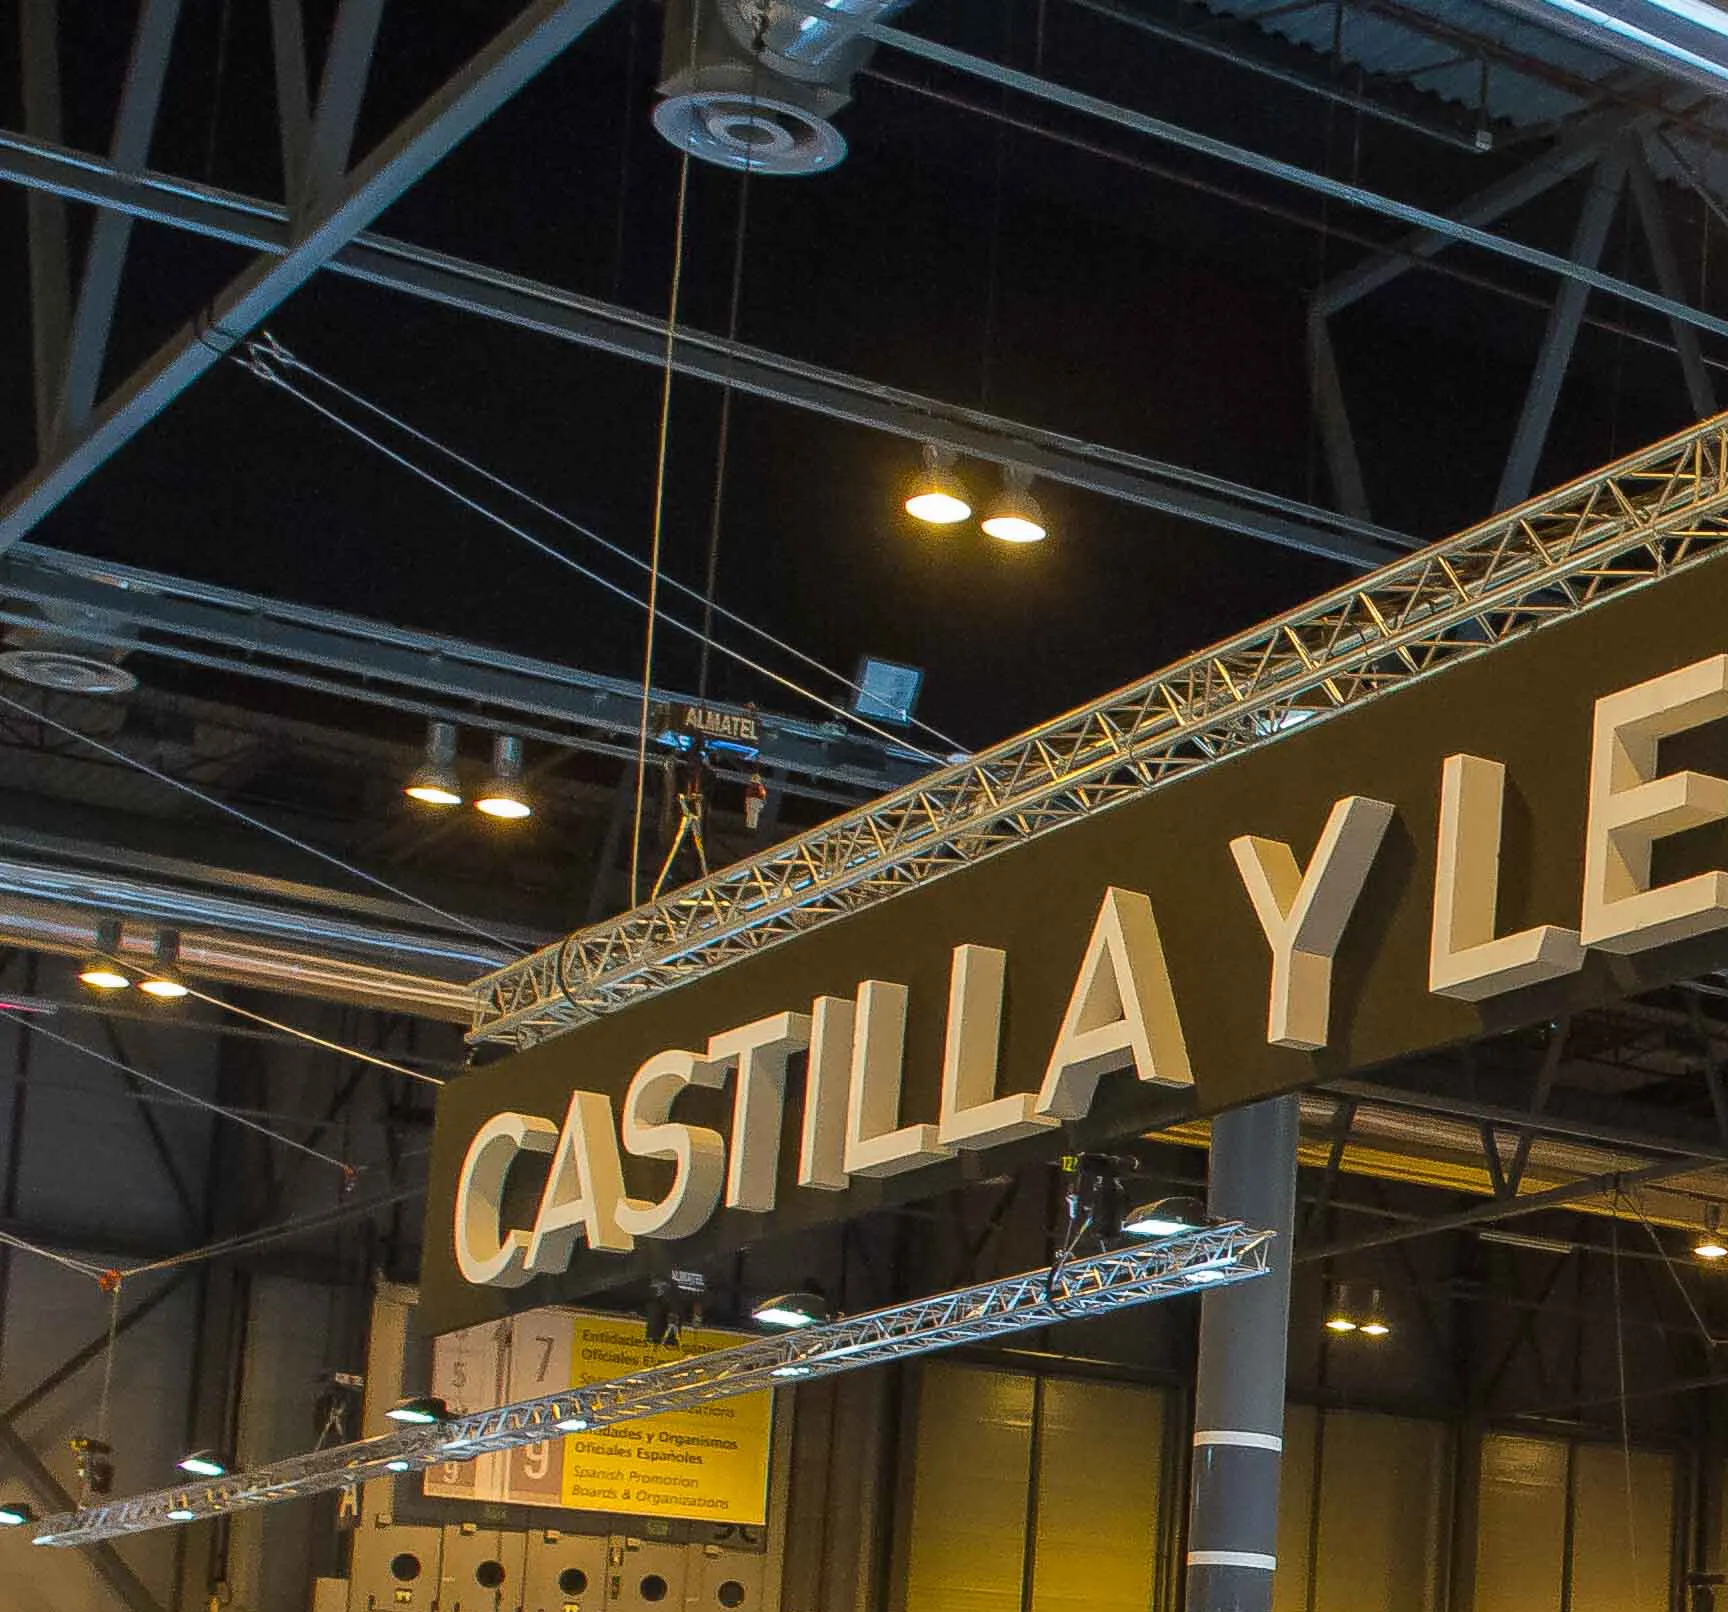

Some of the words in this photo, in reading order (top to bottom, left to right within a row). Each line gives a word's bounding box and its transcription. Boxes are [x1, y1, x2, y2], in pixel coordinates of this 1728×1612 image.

[684, 707, 760, 740] ALMATEL
[455, 887, 1194, 1287] CASTILLA
[1229, 796, 1395, 1051] Y
[582, 1329, 646, 1346] Entidade
[535, 1336, 555, 1383] 7
[575, 1440, 632, 1458] Oficiales
[636, 1446, 704, 1465] Españoles
[659, 1431, 739, 1450] Organismos
[574, 1465, 625, 1482] Spanish
[629, 1470, 699, 1489] Promotion
[571, 1484, 617, 1500] Boards
[635, 1489, 729, 1510] Organizations
